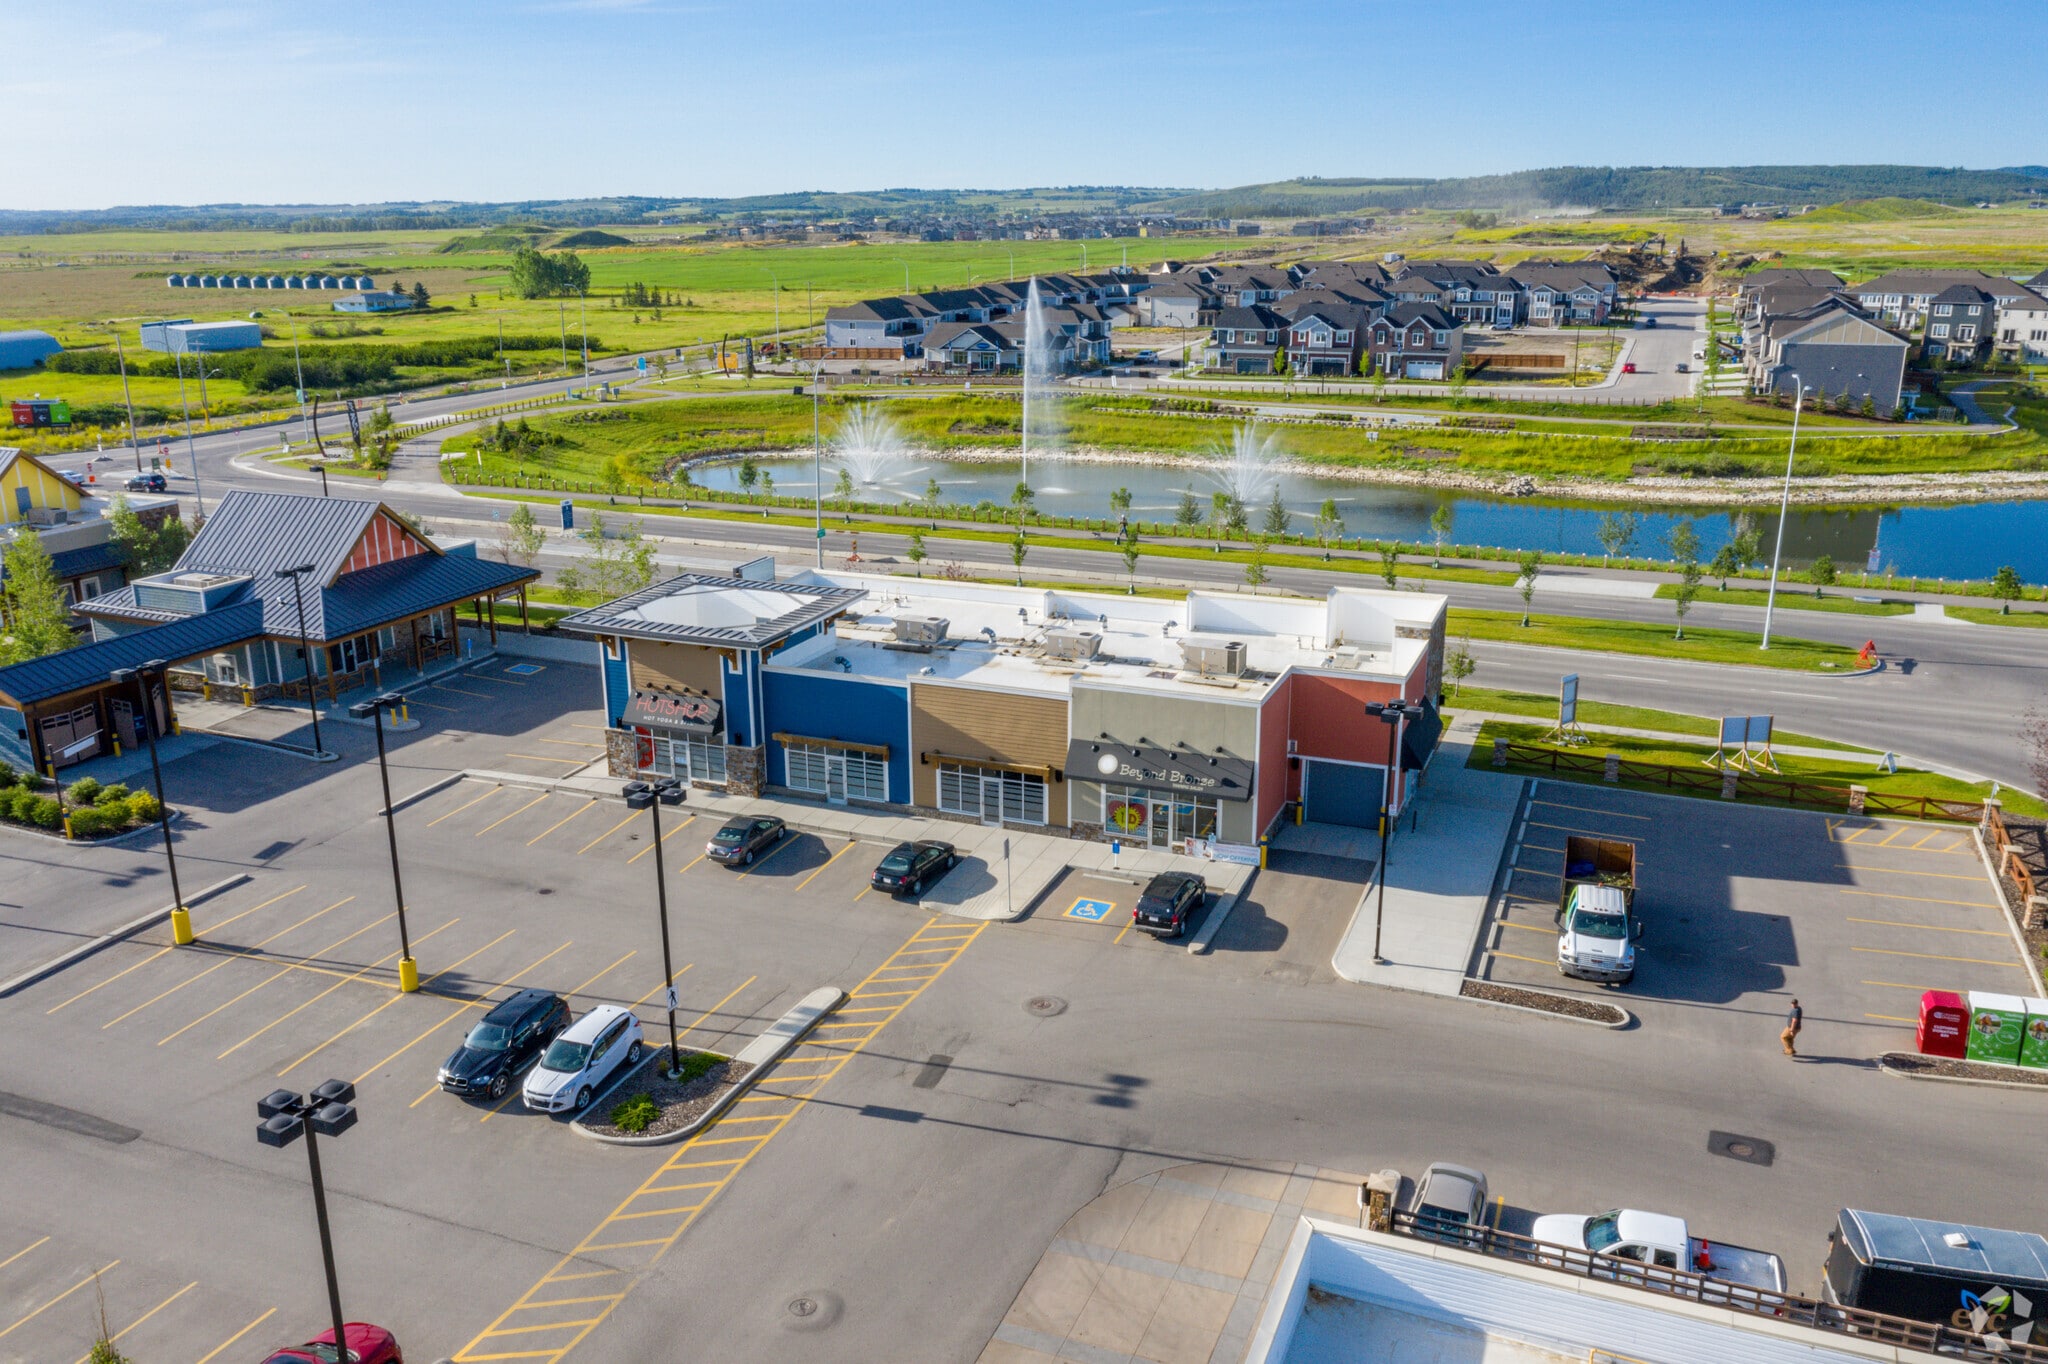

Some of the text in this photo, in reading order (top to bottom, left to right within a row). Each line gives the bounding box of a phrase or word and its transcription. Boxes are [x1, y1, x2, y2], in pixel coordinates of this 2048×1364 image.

[635, 697, 709, 718] HOTSHOP
[1120, 763, 1215, 786] Beyond Bronze
